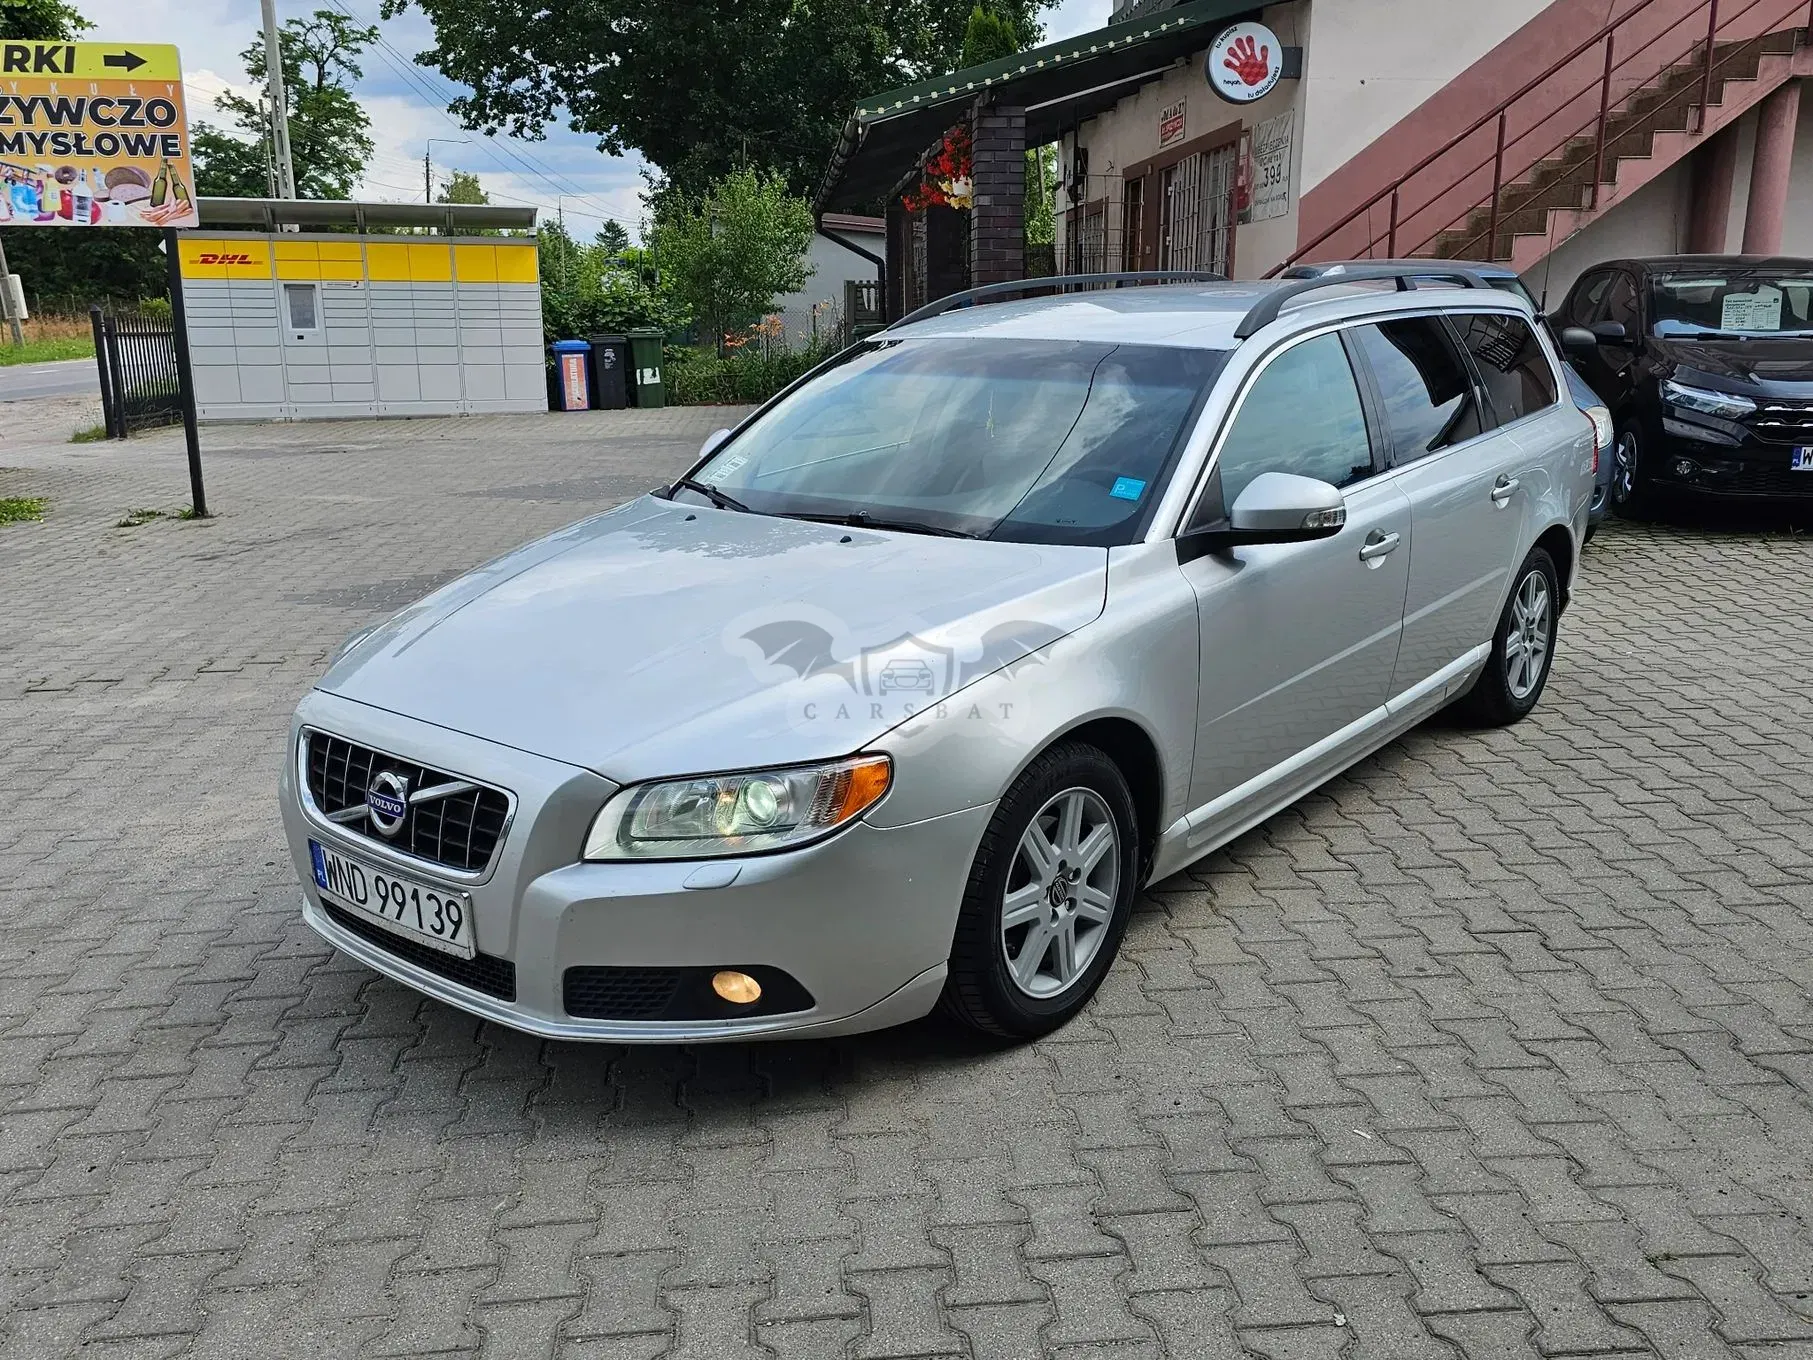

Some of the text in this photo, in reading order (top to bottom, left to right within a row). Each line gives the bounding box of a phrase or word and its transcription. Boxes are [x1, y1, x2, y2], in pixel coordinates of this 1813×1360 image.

[1220, 26, 1238, 43] kupisz
[1254, 66, 1280, 97] doładujesz
[199, 253, 252, 265] DHL
[368, 796, 402, 814] VOLVO
[316, 849, 463, 940] PL WND 99139
